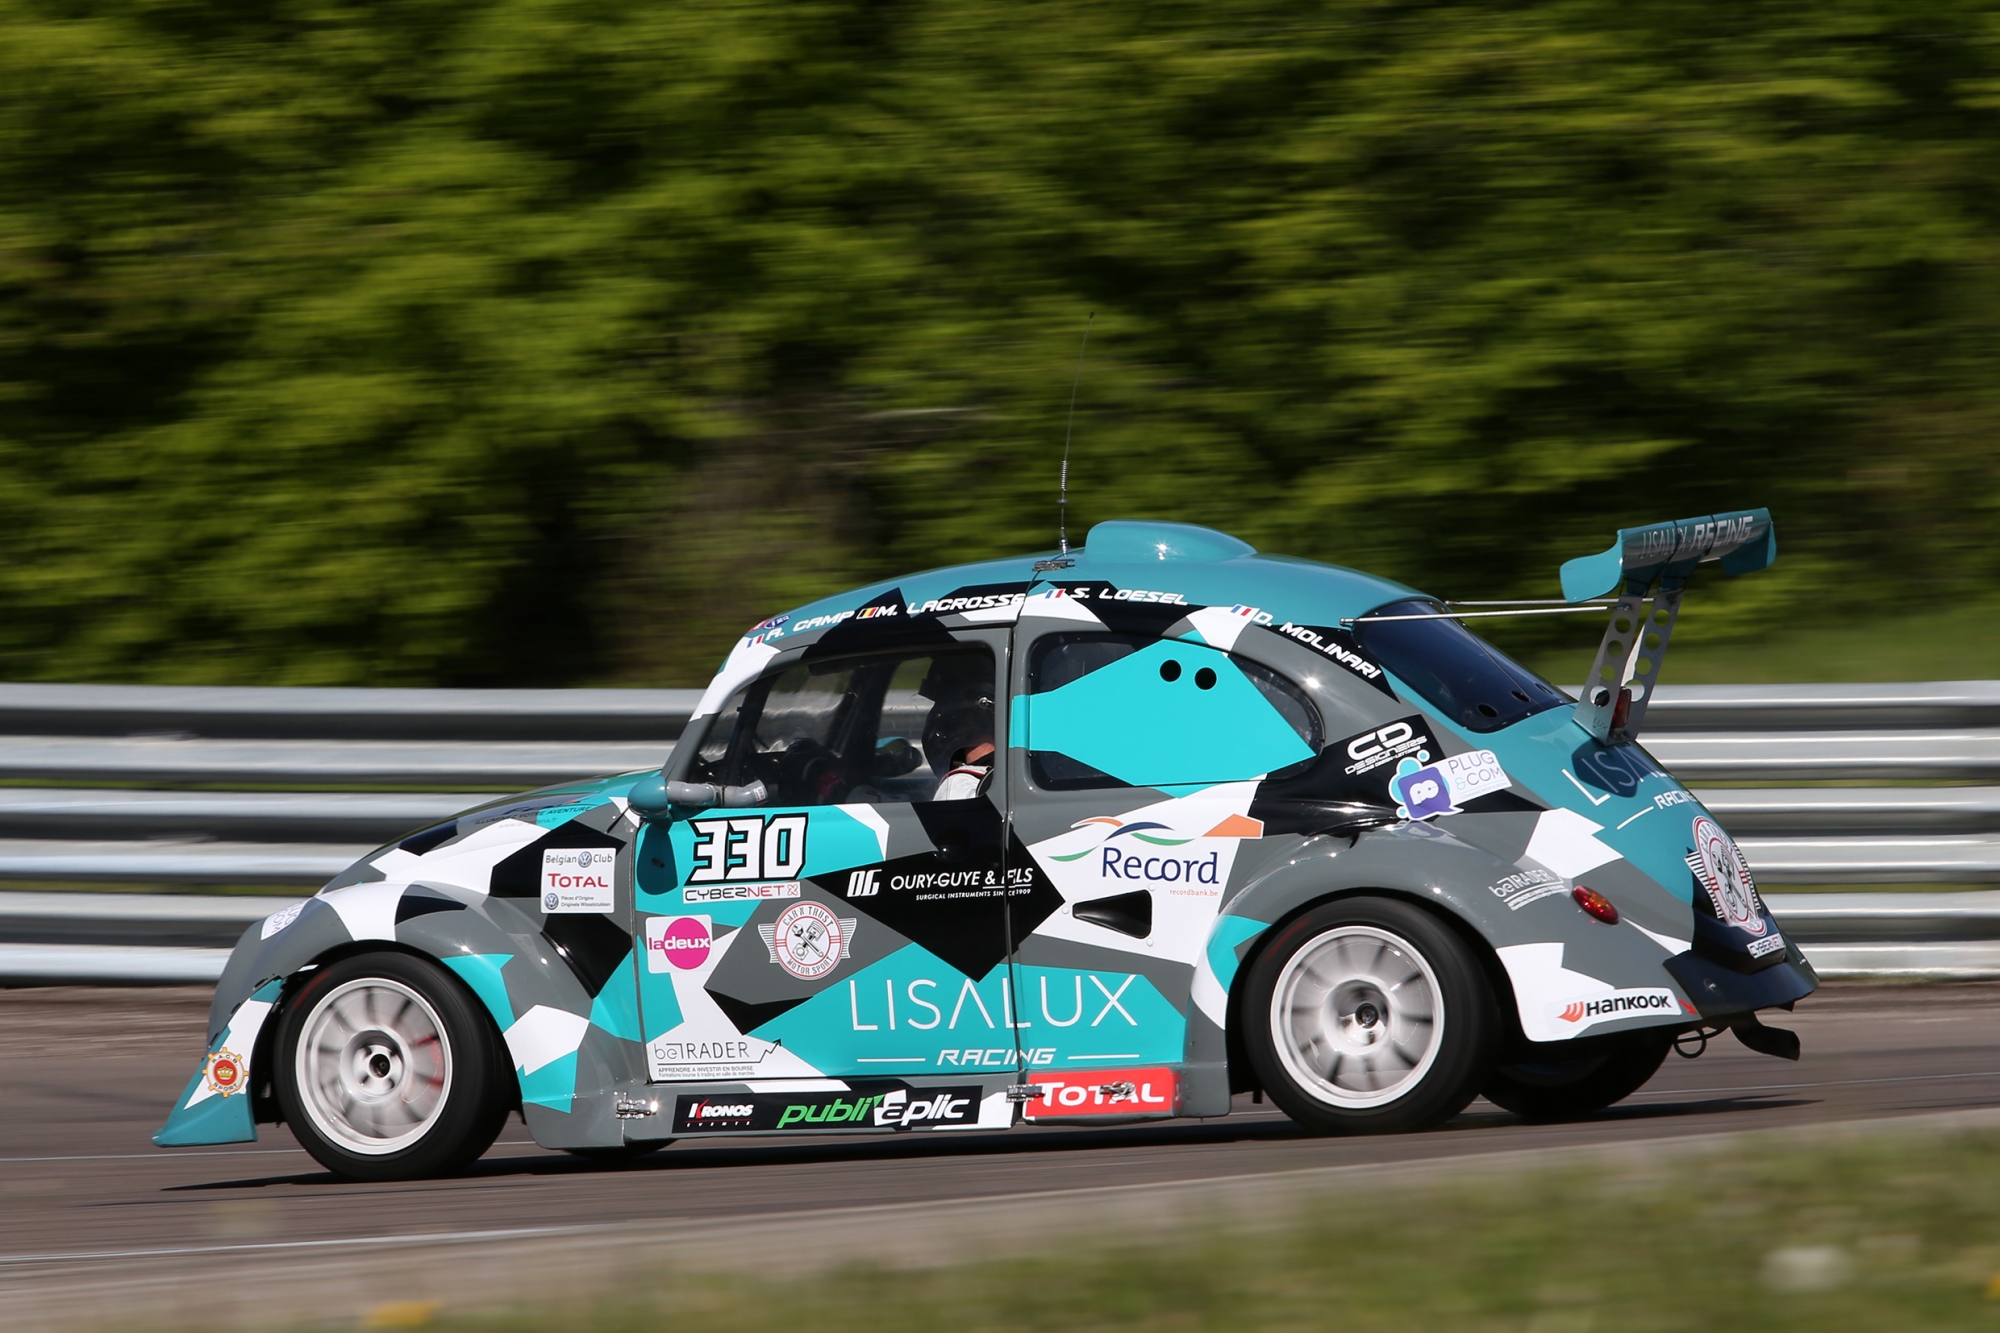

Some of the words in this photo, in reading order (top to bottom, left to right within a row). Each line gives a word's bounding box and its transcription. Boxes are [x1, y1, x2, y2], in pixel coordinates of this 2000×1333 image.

[1070, 587, 1090, 599] S.
[1099, 587, 1189, 606] LOESEL
[875, 604, 899, 618] M.
[765, 627, 785, 641] A.
[792, 610, 855, 632] CAMP
[1253, 611, 1273, 627] D.
[1279, 621, 1382, 680] MOLINARI
[1448, 751, 1495, 775] PLUG
[544, 806, 593, 815] AVENTURE
[686, 814, 808, 884] 330
[545, 854, 577, 866] Belgian
[593, 853, 613, 863] Club
[1102, 847, 1220, 884] Record
[547, 873, 609, 888] TOTAL
[890, 871, 981, 890] OURY-GUYE
[984, 870, 996, 885] &
[915, 893, 946, 901] SURGICAL
[947, 891, 991, 899] INSTRUMENTS
[1169, 889, 1219, 897] recordbank.be
[808, 906, 834, 927] TRUST
[786, 958, 810, 974] MOTOR
[812, 956, 833, 974] SPORT
[849, 974, 1138, 1031] LISALUX
[654, 1041, 750, 1059] beTRADER
[936, 1047, 1057, 1066] RACING
[213, 1082, 237, 1091] SPORT
[1034, 1081, 1165, 1107] TOTAL
